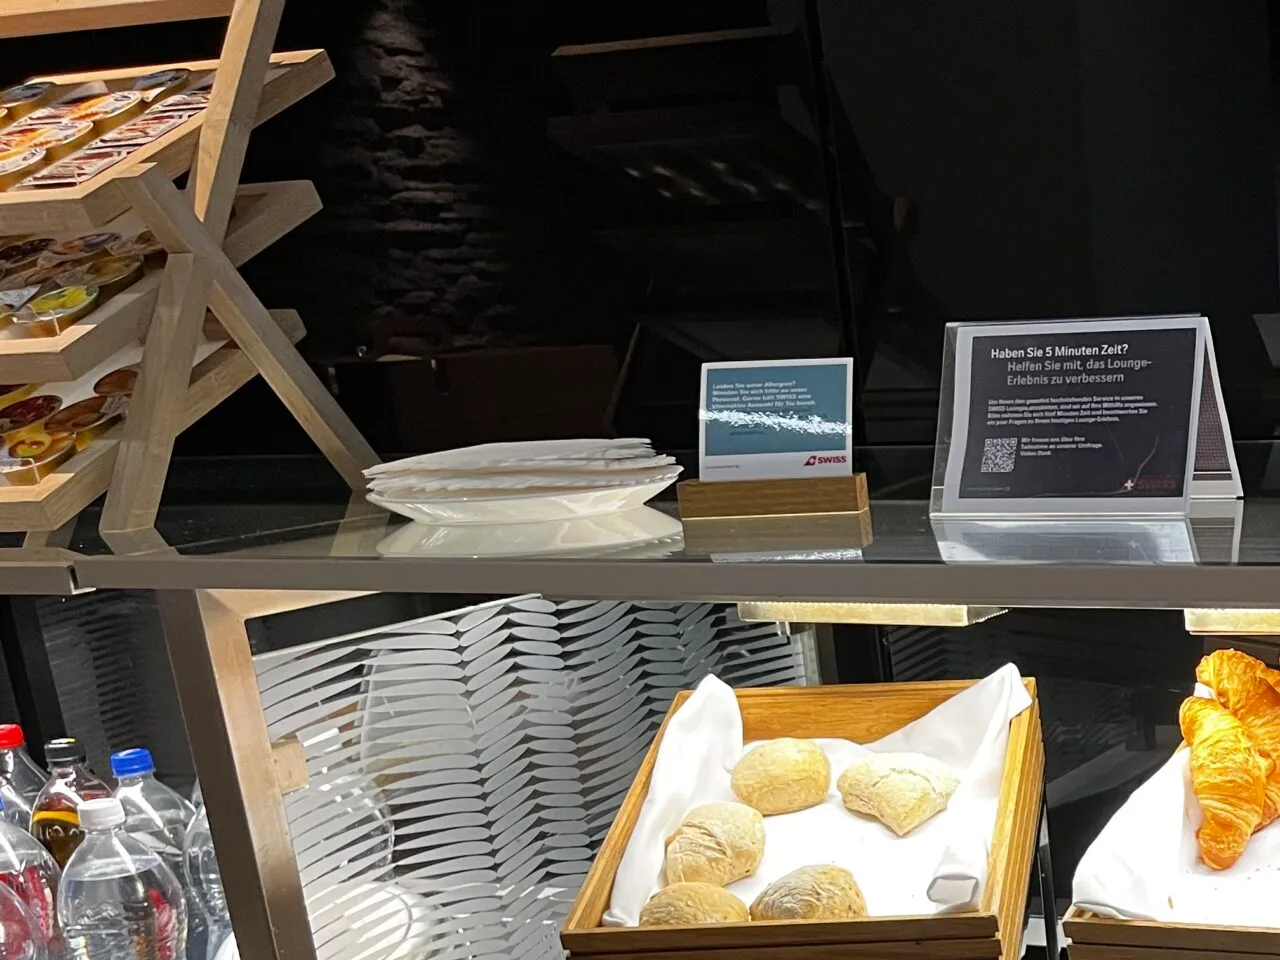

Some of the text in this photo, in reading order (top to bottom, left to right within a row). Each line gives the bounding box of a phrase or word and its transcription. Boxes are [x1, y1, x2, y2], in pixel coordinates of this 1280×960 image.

[991, 343, 1129, 359] Haben Sie 5 Minuten Zeit?
[1007, 361, 1042, 372] Helfen
[1044, 360, 1061, 371] Sie
[1086, 358, 1105, 369] das
[1107, 358, 1153, 370] Lounge-
[1007, 372, 1124, 386] Erlebnis zu verbessern
[817, 455, 847, 464] SWISS
